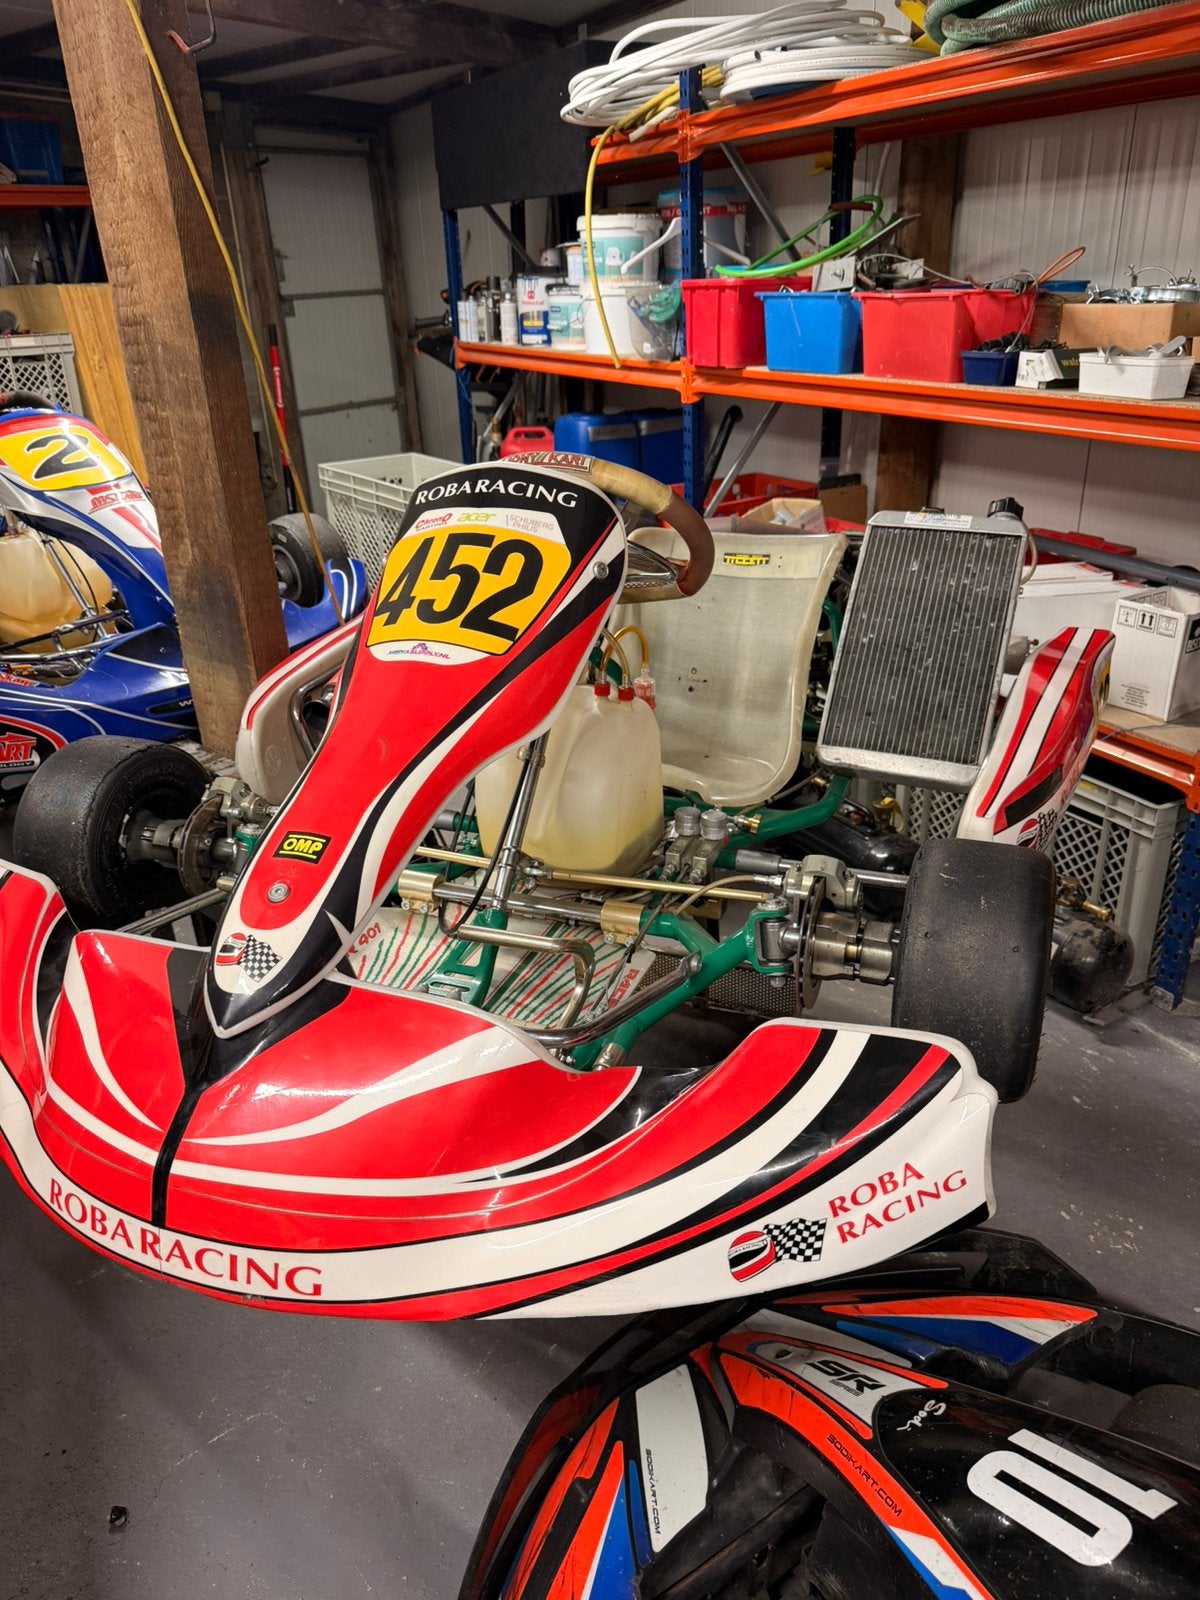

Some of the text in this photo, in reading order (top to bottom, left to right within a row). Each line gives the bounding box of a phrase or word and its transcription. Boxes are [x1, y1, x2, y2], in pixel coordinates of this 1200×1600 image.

[25, 434, 100, 480] 2
[457, 512, 497, 523] acer
[374, 532, 543, 642] 452
[0, 740, 37, 762] ART
[282, 838, 323, 855] OMP
[828, 1162, 924, 1218] ROBA
[836, 1170, 968, 1244] RACING
[966, 1428, 1179, 1567] 10
